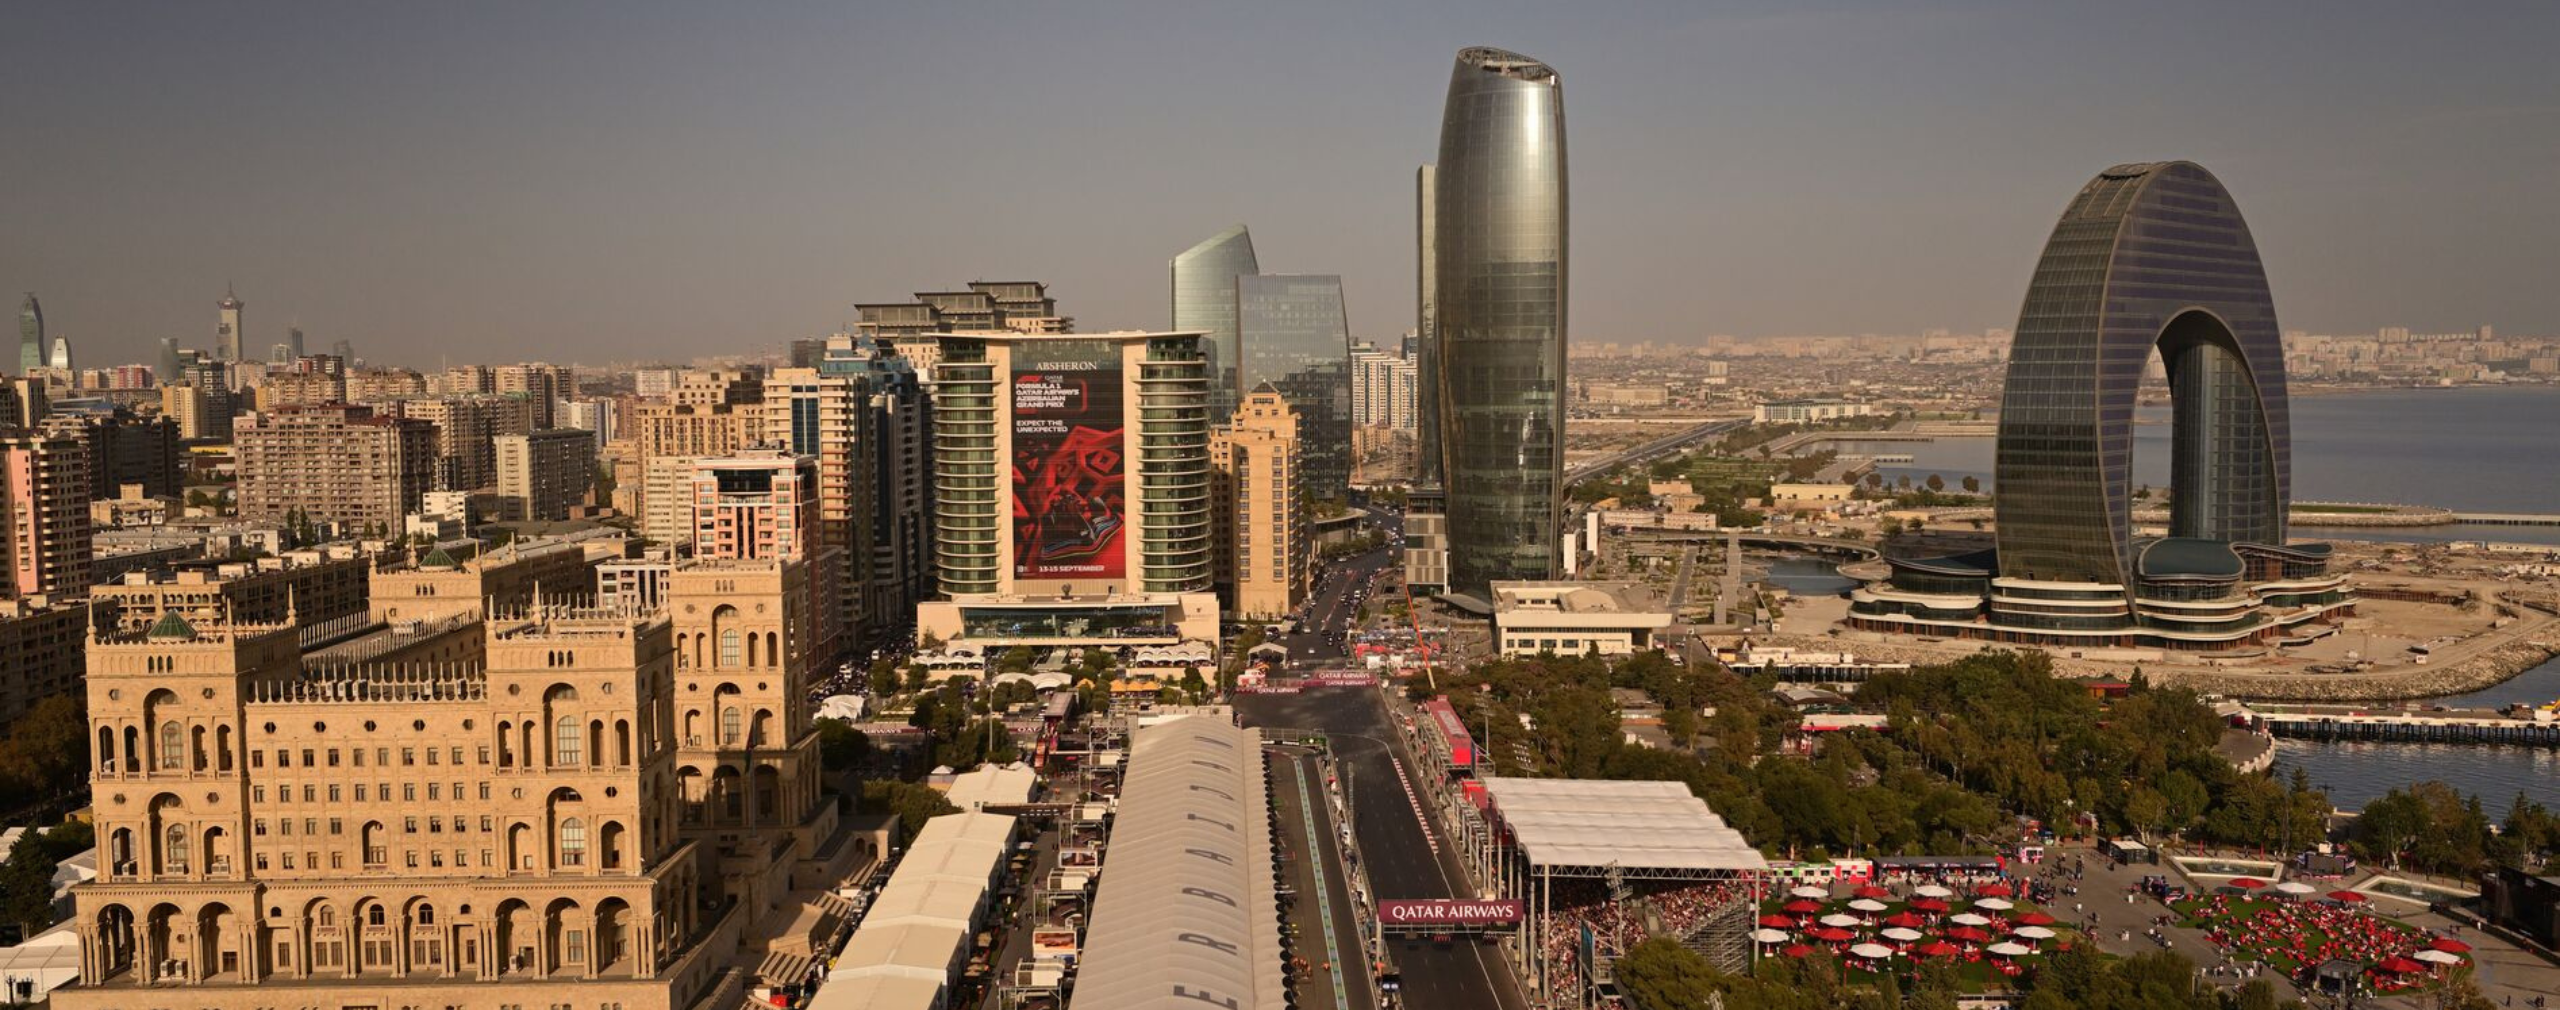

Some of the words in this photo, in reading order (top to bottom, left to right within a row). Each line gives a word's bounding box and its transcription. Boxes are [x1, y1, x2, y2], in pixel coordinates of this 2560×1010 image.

[1036, 361, 1097, 371] ABSHERON
[1392, 905, 1445, 920] QATAR
[1449, 905, 1514, 918] AIRWAYS
